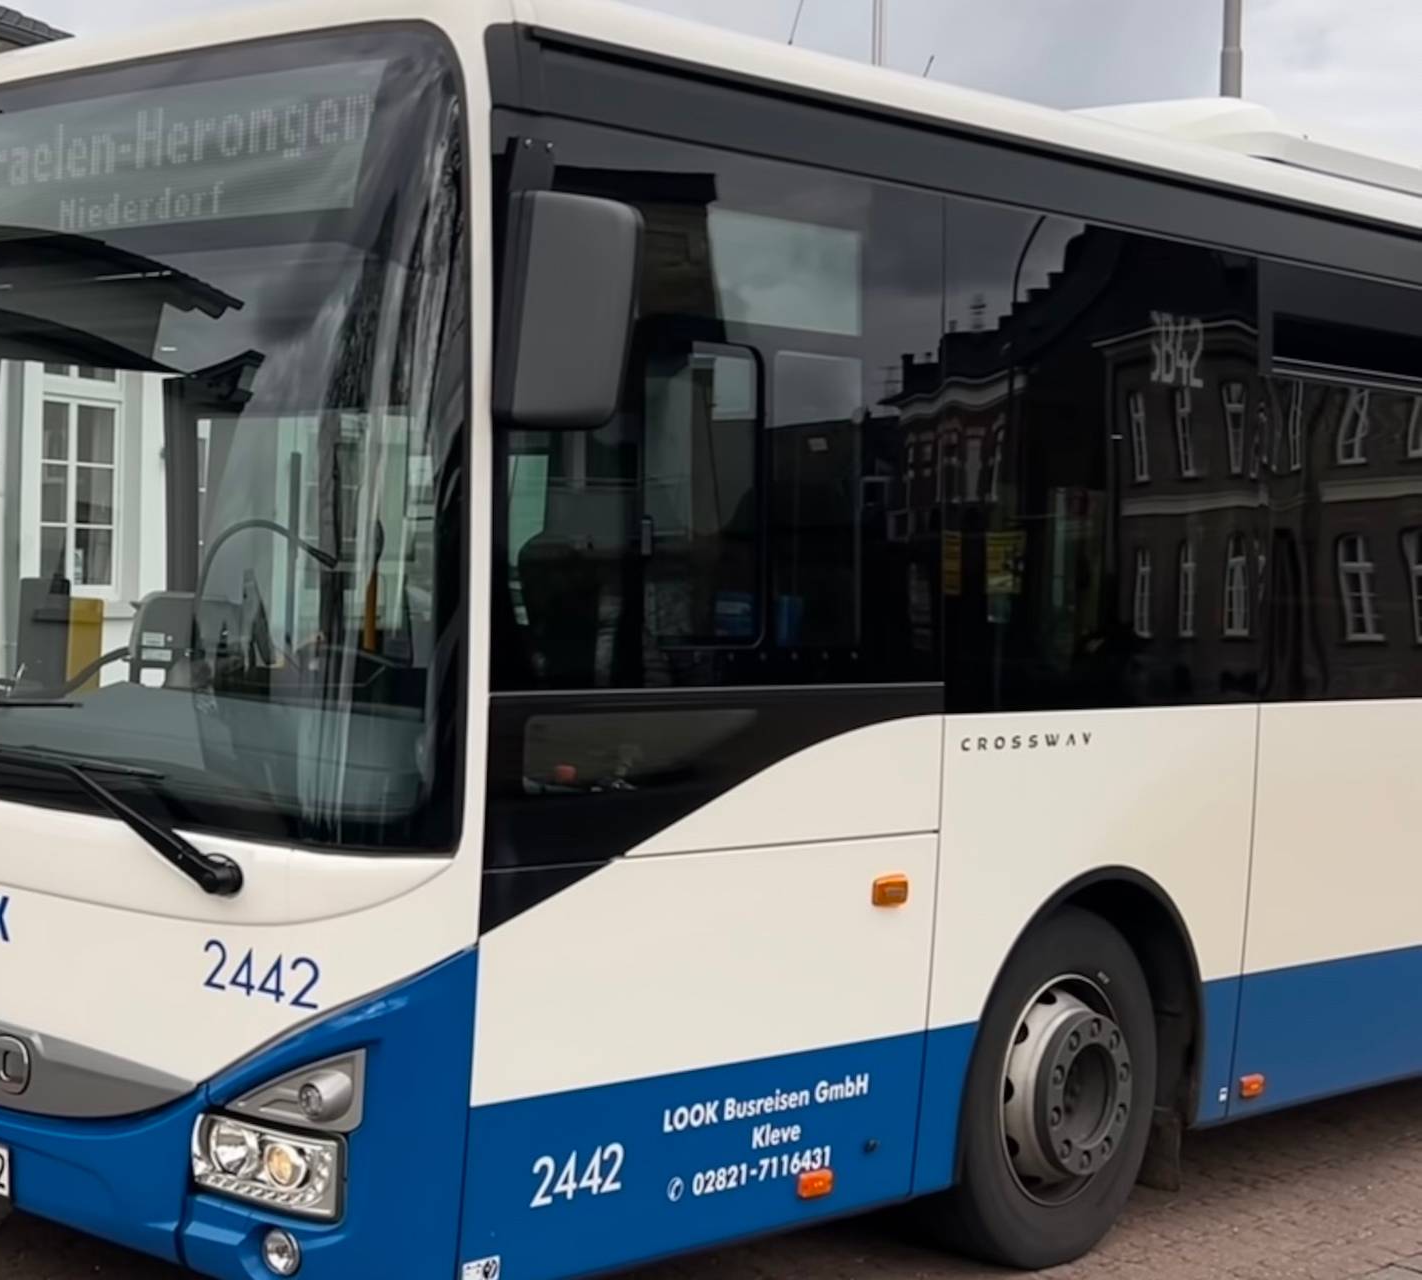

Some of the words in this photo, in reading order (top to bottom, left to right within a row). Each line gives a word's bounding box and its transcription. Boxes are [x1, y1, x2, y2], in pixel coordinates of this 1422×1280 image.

[58, 181, 226, 233] Niederdorf
[1150, 310, 1204, 388] SB42
[202, 938, 321, 1011] 2442
[663, 1100, 719, 1133] LOOK
[723, 1088, 810, 1121] Busreisen
[814, 1072, 870, 1104] GmbH
[751, 1122, 803, 1151] Kleve
[529, 1142, 626, 1208] 2442
[692, 1145, 831, 1196] 02821-7116431
